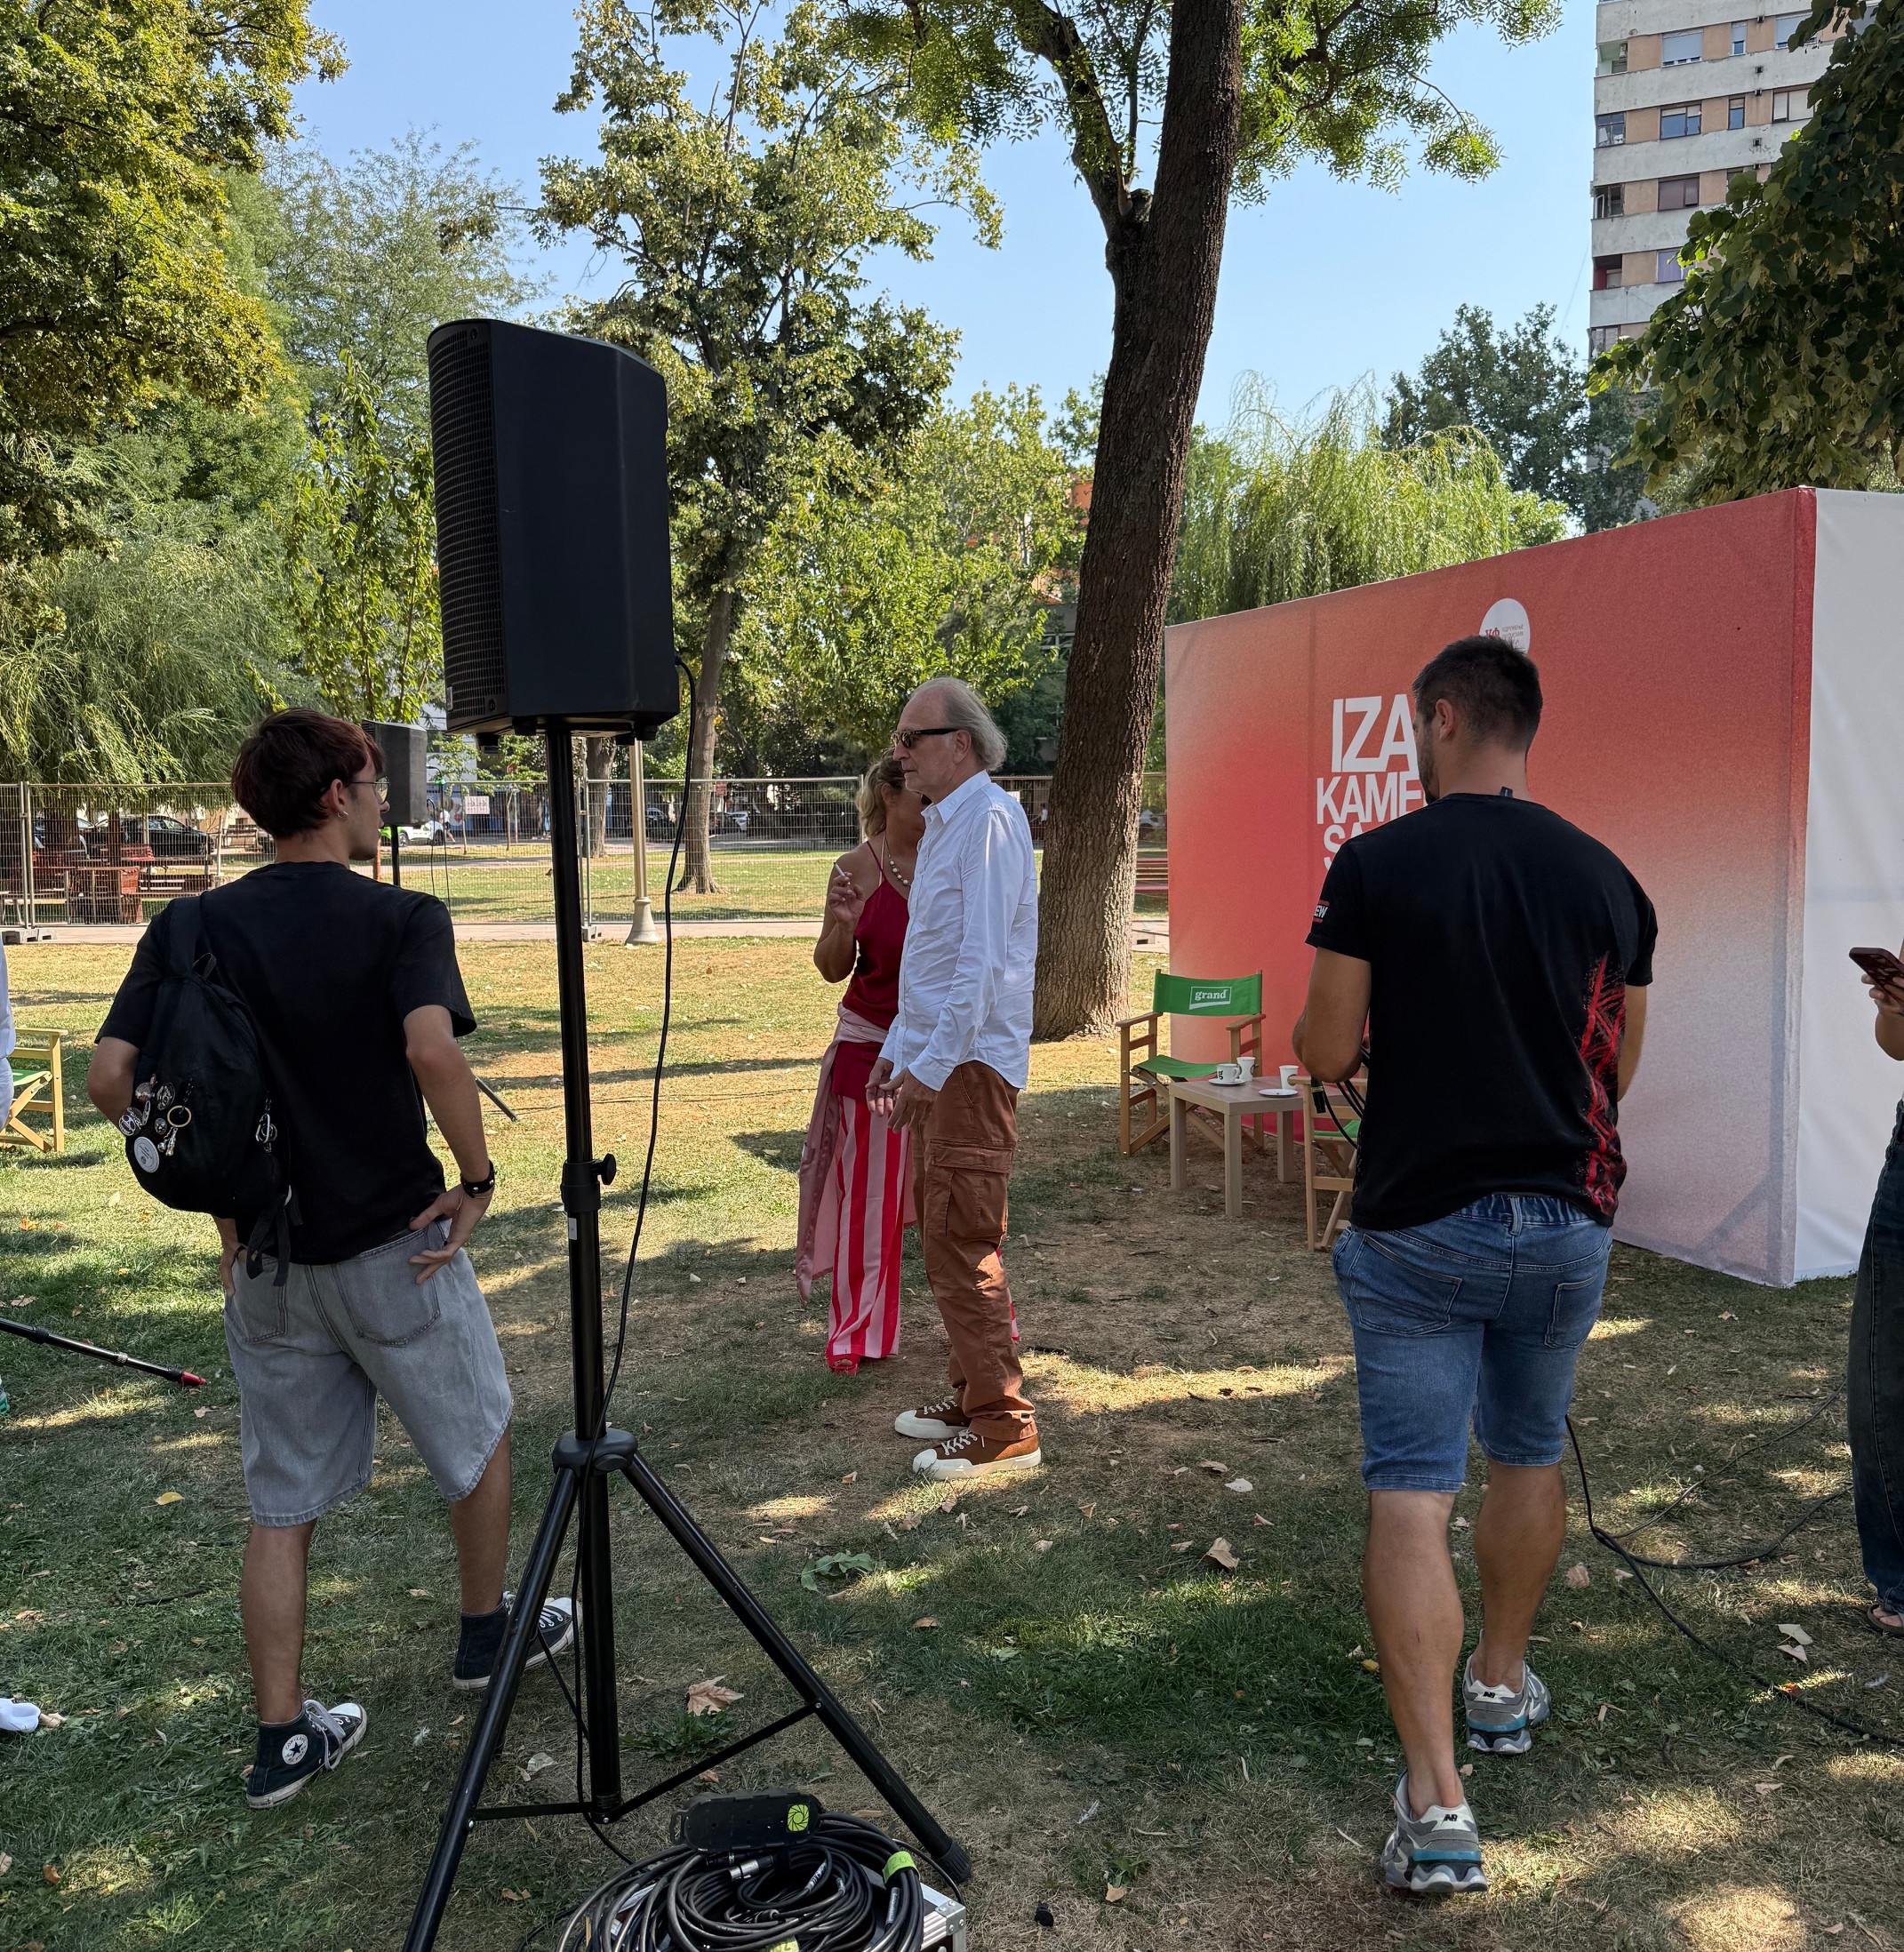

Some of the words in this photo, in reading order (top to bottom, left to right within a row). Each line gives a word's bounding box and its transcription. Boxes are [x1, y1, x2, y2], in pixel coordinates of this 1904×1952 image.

[1332, 693, 1420, 772] IZA
[1316, 771, 1428, 824] KAME
[1195, 988, 1228, 1001] grand
